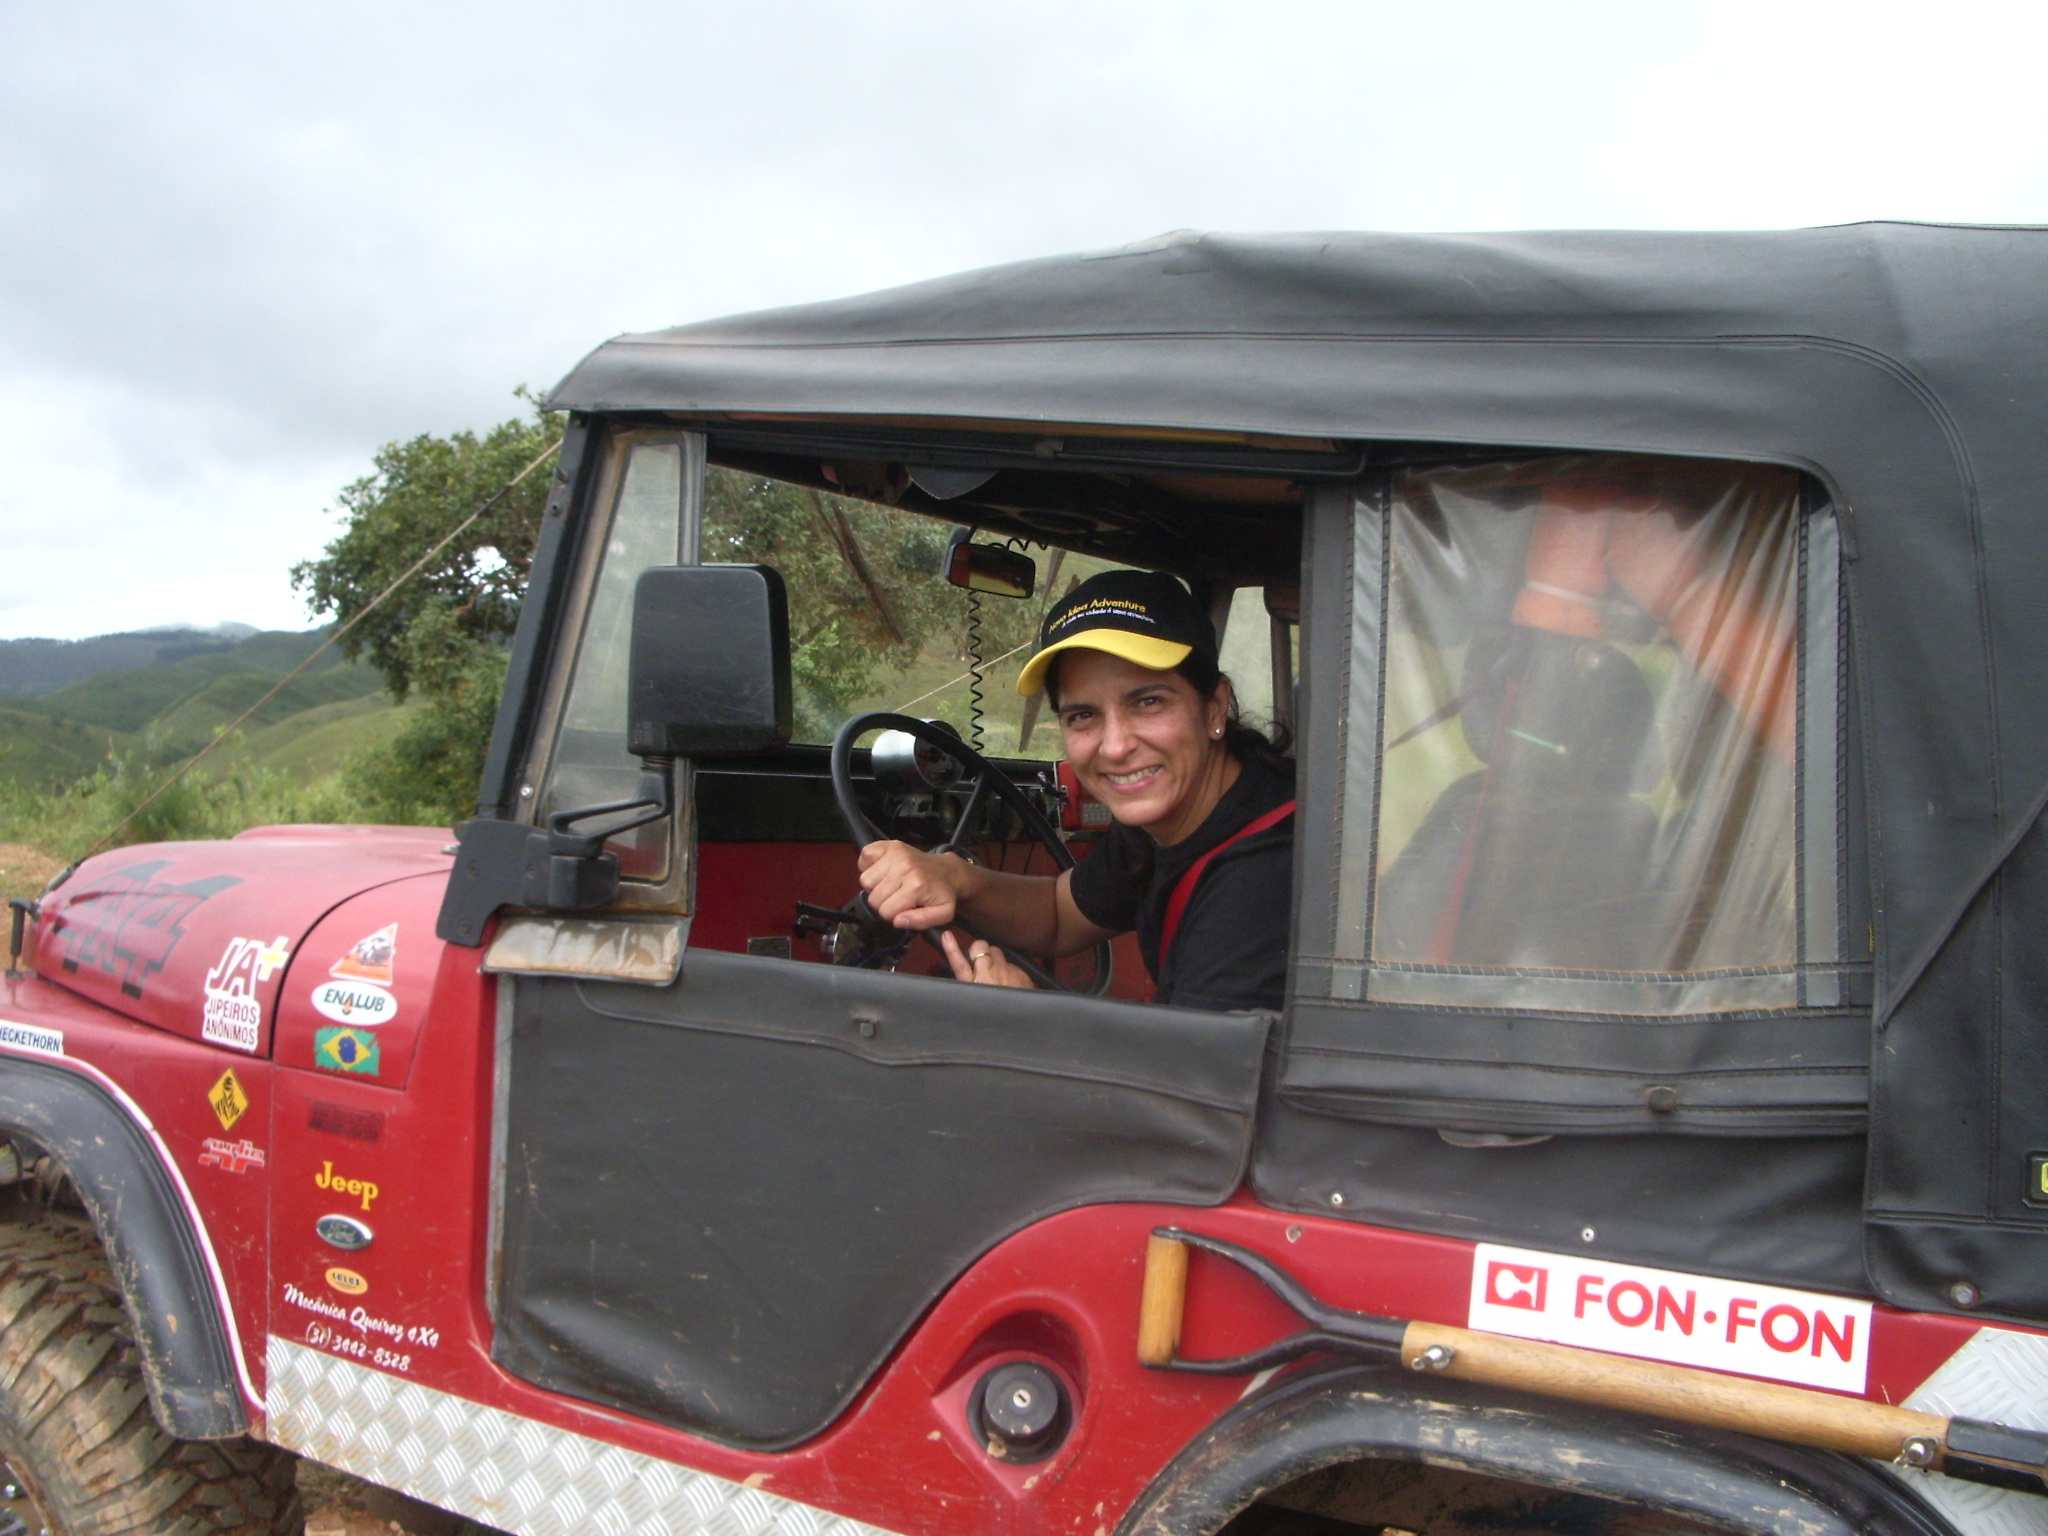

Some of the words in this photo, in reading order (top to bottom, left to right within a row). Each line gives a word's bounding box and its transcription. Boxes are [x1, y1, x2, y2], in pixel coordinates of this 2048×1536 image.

[1090, 598, 1147, 613] Adventure
[206, 998, 257, 1024] JIPEIROS
[323, 988, 386, 1013] ENALUB
[315, 1160, 378, 1211] Jeep
[350, 1306, 404, 1343] Queiroz
